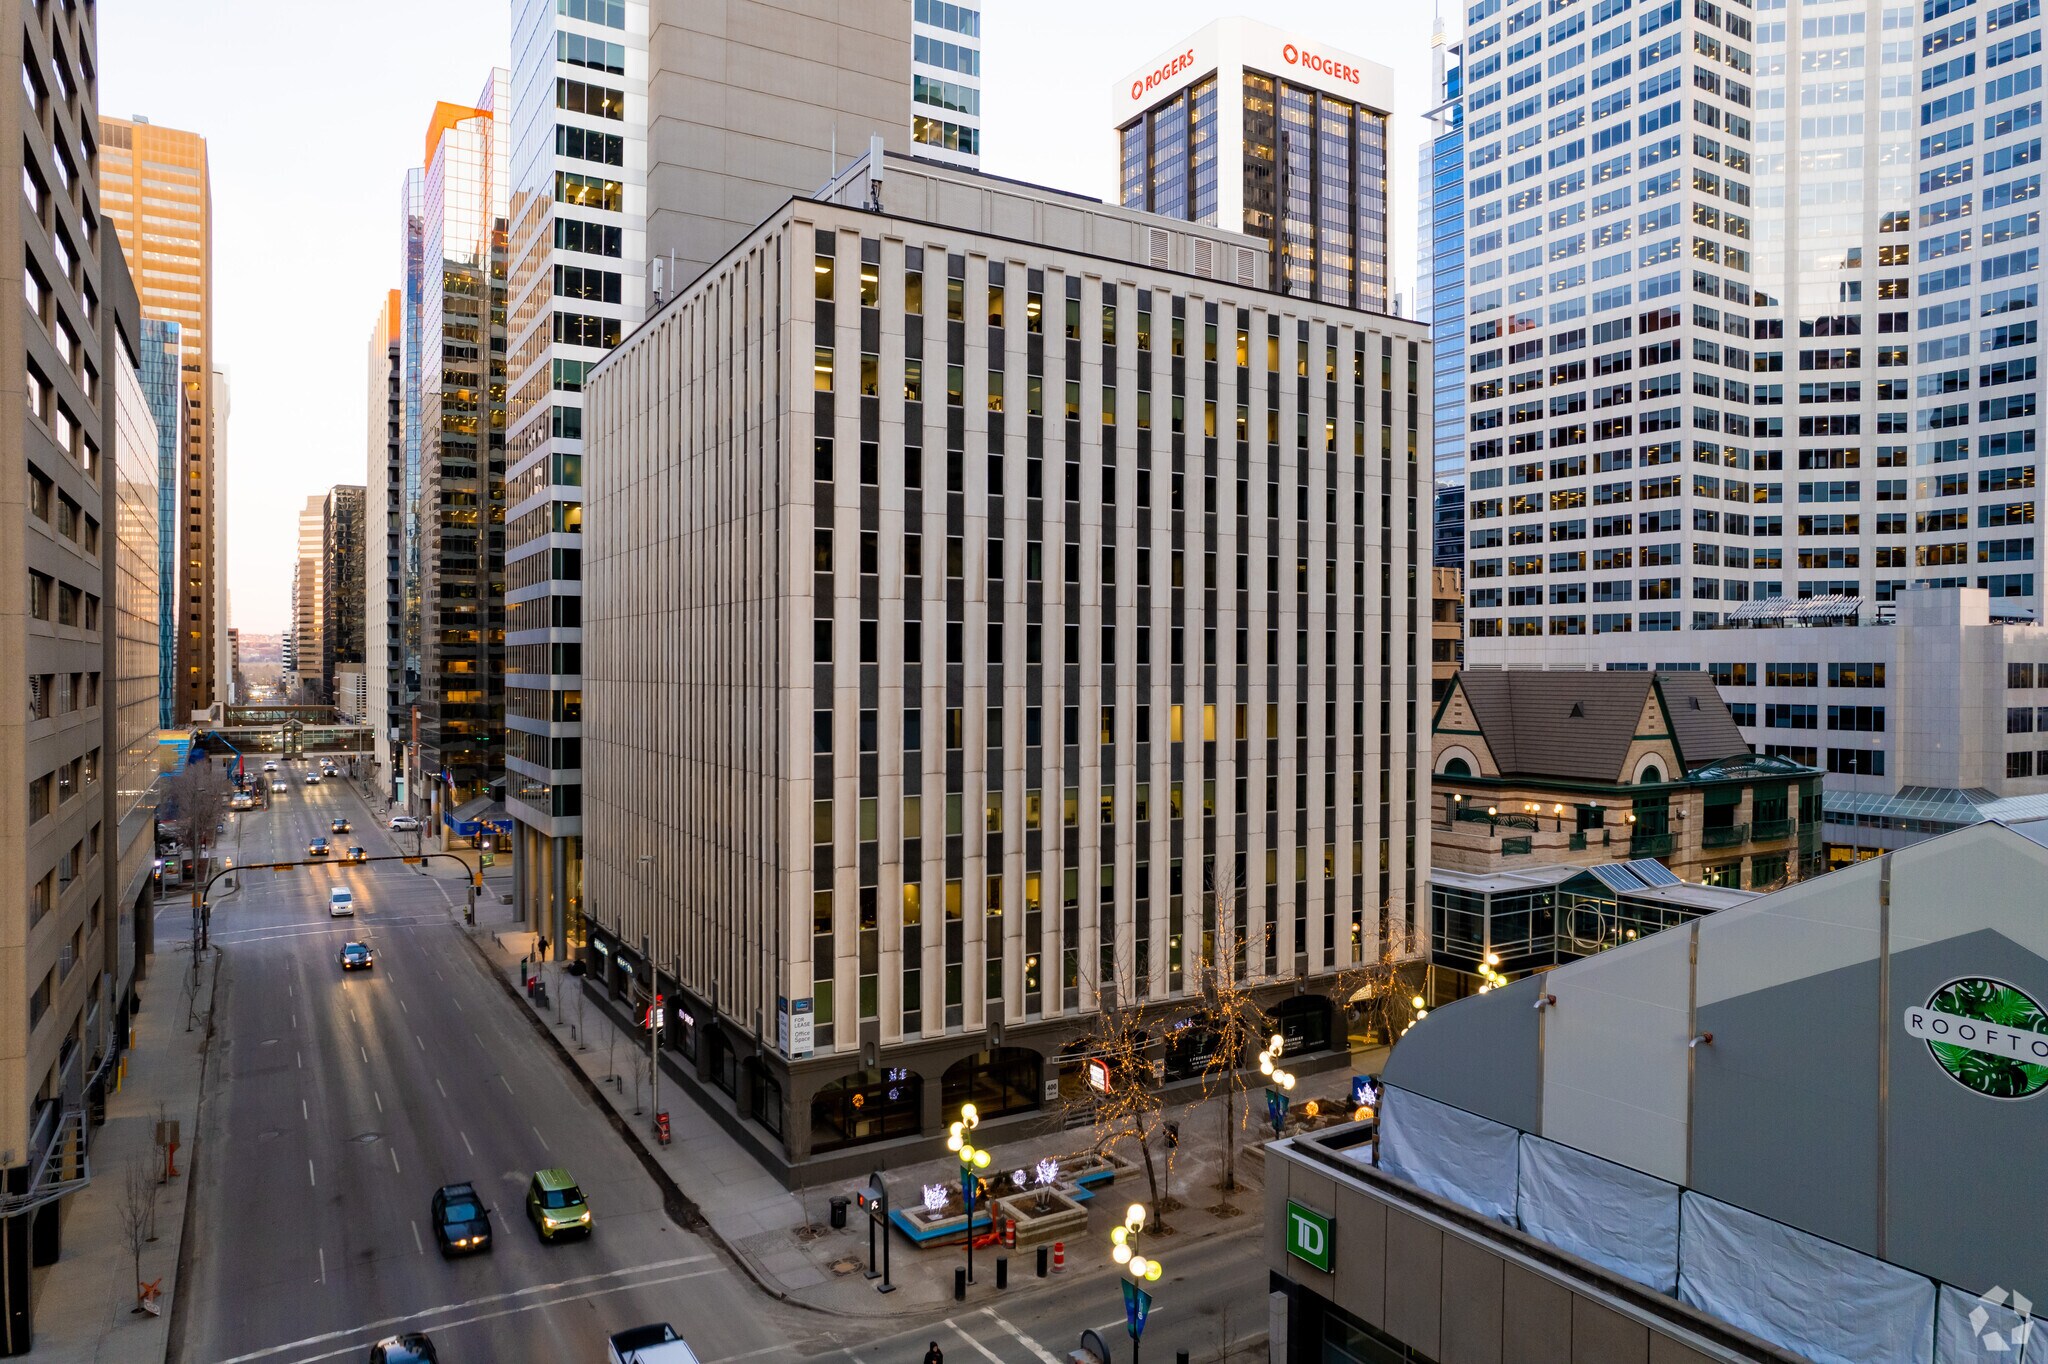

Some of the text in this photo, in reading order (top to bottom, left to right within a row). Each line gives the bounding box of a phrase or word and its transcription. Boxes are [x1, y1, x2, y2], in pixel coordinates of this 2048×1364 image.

[1145, 48, 1194, 92] ROGERS
[1302, 51, 1360, 85] ROGERS
[1912, 1013, 2048, 1058] ROOFTO
[1047, 1083, 1057, 1091] 400
[1291, 1212, 1324, 1256] TD
